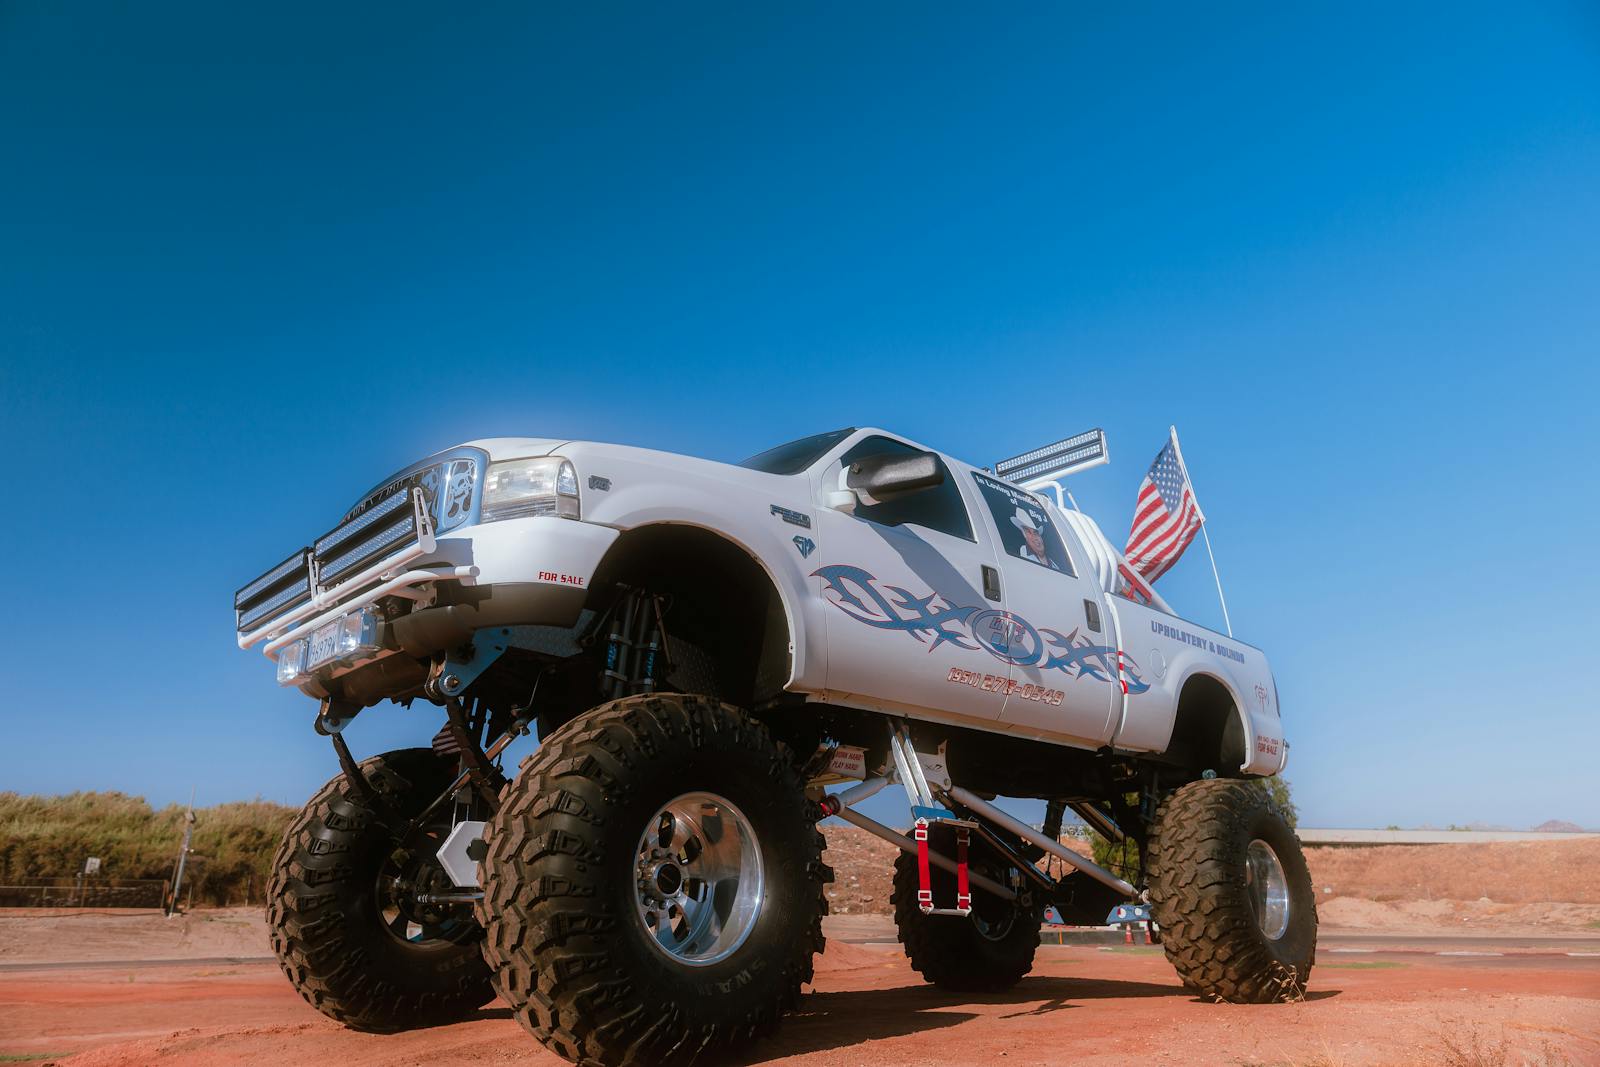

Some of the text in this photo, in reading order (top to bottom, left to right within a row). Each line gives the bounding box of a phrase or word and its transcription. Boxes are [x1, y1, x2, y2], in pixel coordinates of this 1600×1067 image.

[985, 479, 1011, 497] Loving
[538, 571, 584, 585] FOR SALE
[1151, 620, 1207, 650] UPHOLSTERY
